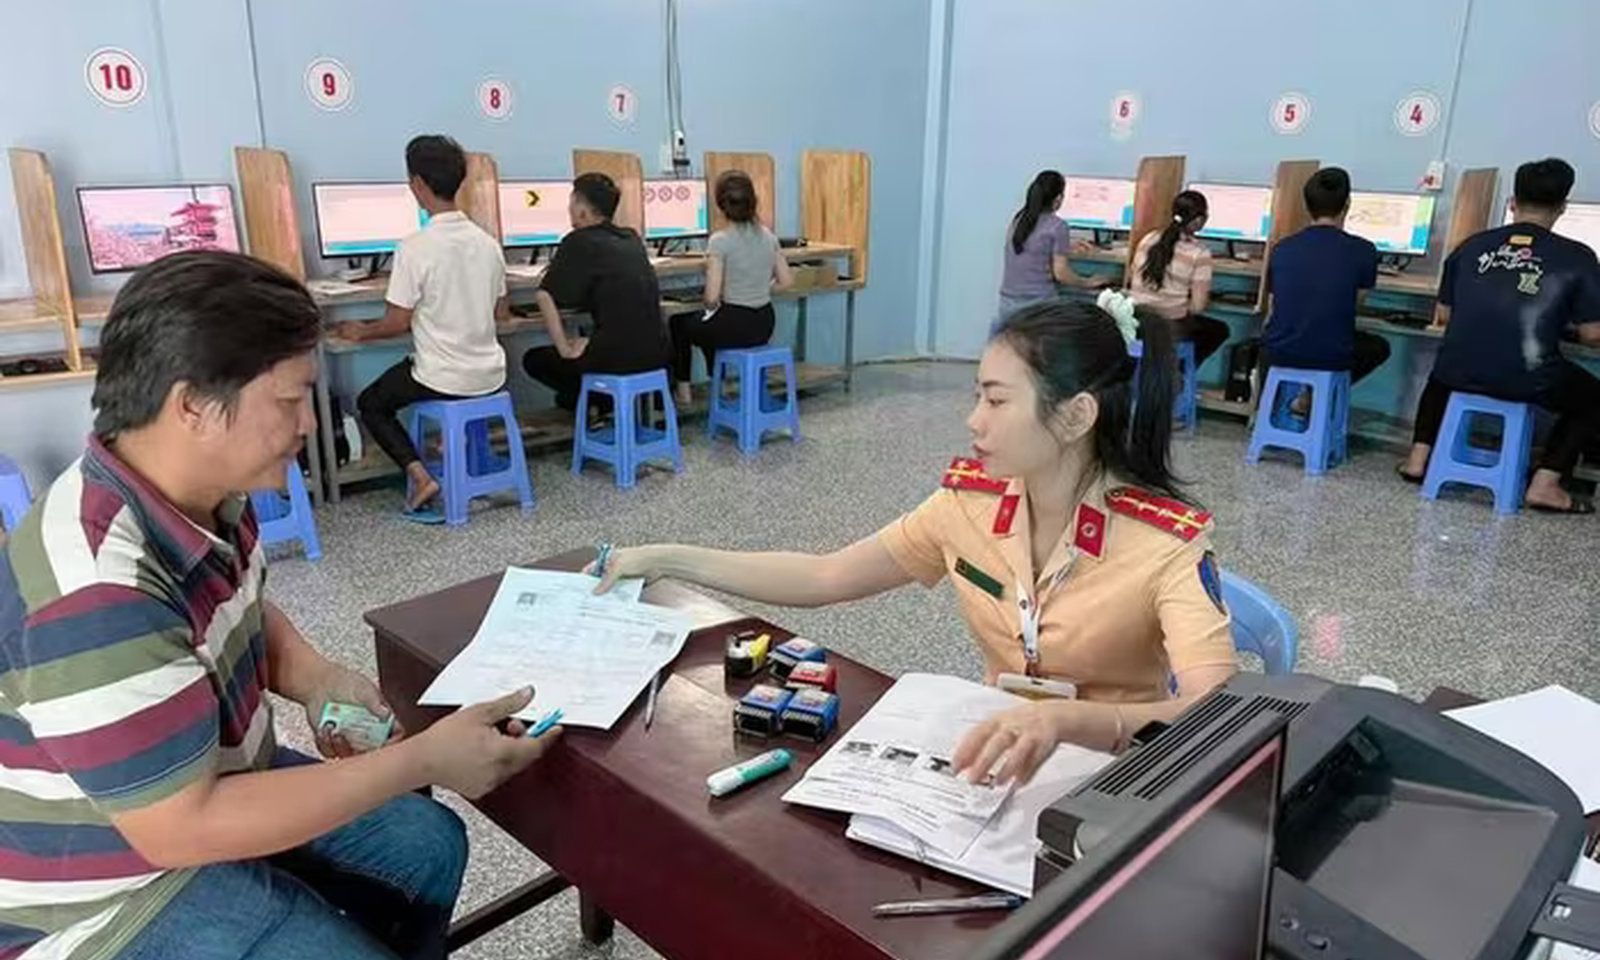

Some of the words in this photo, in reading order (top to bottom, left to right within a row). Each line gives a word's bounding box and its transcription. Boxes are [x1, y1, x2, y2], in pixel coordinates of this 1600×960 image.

[99, 64, 133, 91] 10
[322, 74, 337, 97] 9
[489, 88, 501, 109] 8
[615, 93, 626, 112] 7
[1119, 100, 1130, 118] 6
[1284, 103, 1297, 123] 5
[1409, 103, 1423, 124] 4
